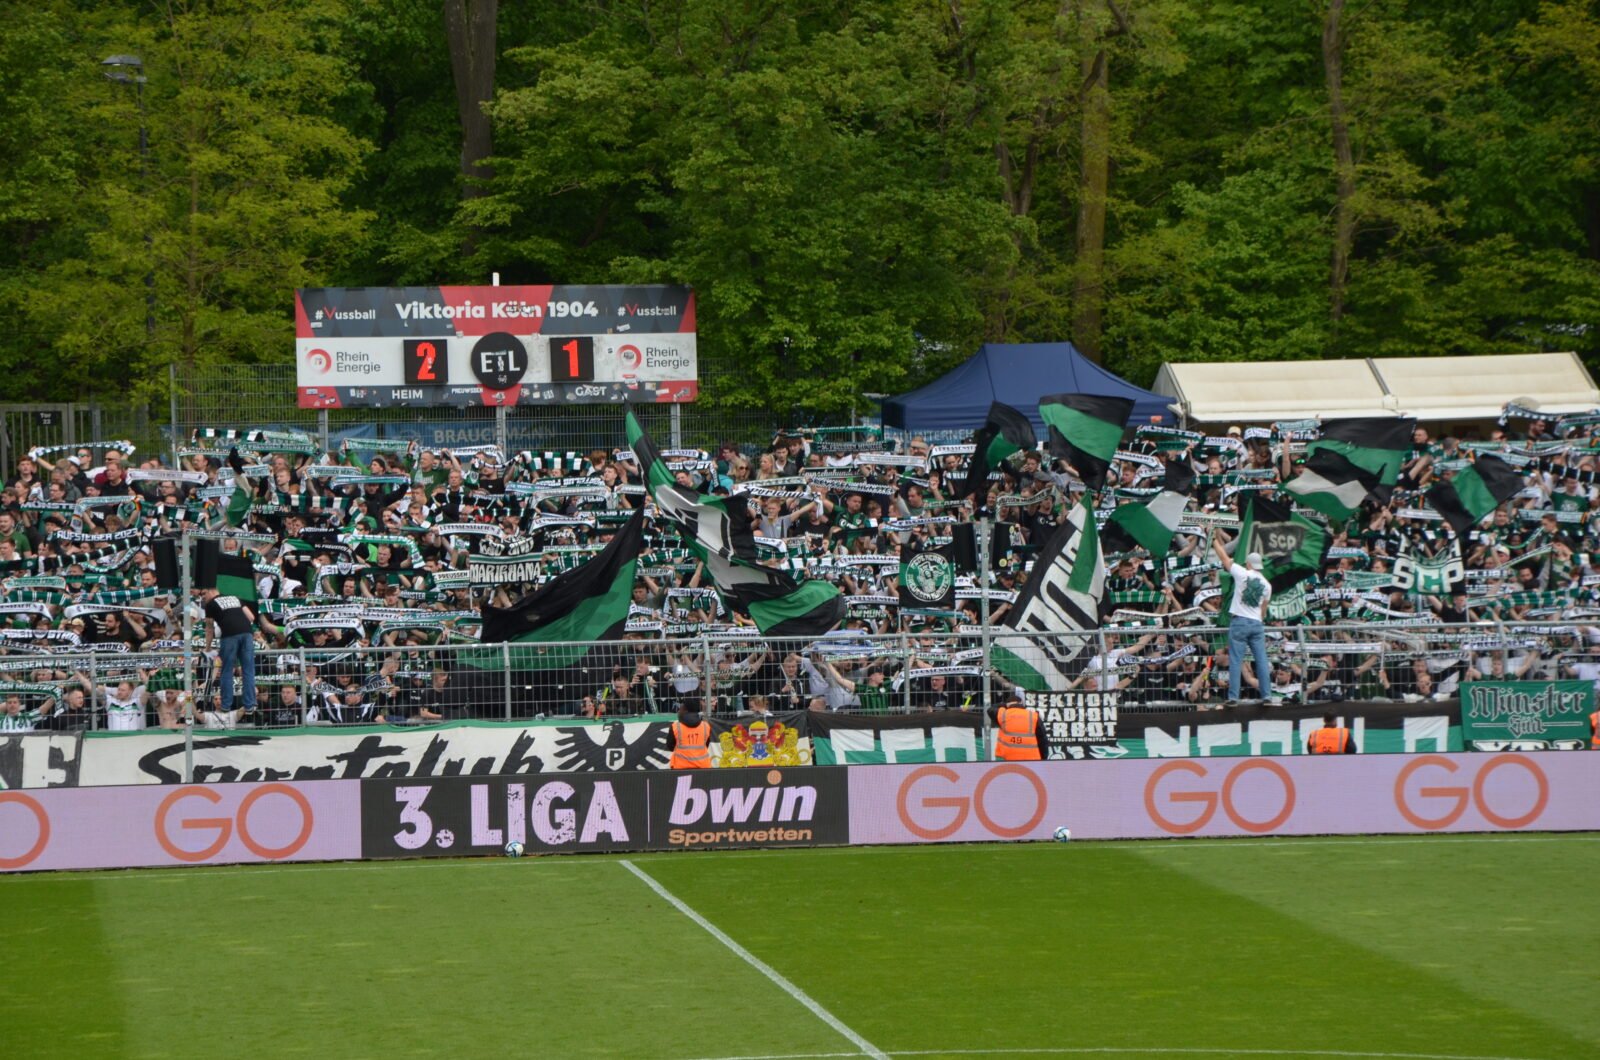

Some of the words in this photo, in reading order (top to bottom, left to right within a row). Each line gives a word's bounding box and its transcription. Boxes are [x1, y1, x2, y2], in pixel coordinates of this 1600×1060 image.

[315, 306, 376, 320] #Vussball
[395, 300, 486, 319] Viktoria
[547, 300, 598, 318] 1904
[336, 351, 369, 362] Rhein
[416, 342, 436, 380] 2
[562, 339, 579, 377] 1
[646, 347, 678, 357] Rhein
[336, 361, 381, 375] Energie
[646, 357, 690, 370] Energie
[391, 389, 423, 400] HEIM
[575, 385, 607, 397] GAST
[1182, 516, 1211, 525] PREUSSEN
[56, 529, 113, 542] AUFSTEIGER
[113, 527, 139, 540] 2023
[1391, 557, 1465, 593] SCP
[1025, 692, 1118, 709] SEKTION
[1468, 683, 1587, 722] Münster
[1043, 721, 1118, 738] ERBOT
[1508, 713, 1548, 739] Süd
[686, 732, 700, 745] 117
[1010, 736, 1023, 745] 49
[668, 769, 818, 825] bwin
[1144, 757, 1296, 835] GO
[1394, 753, 1550, 830] GO
[896, 763, 1048, 840] GO
[154, 783, 314, 862] GO
[393, 785, 455, 850] 3.
[470, 780, 631, 846] LIGA
[668, 827, 813, 847] Sportwetten
